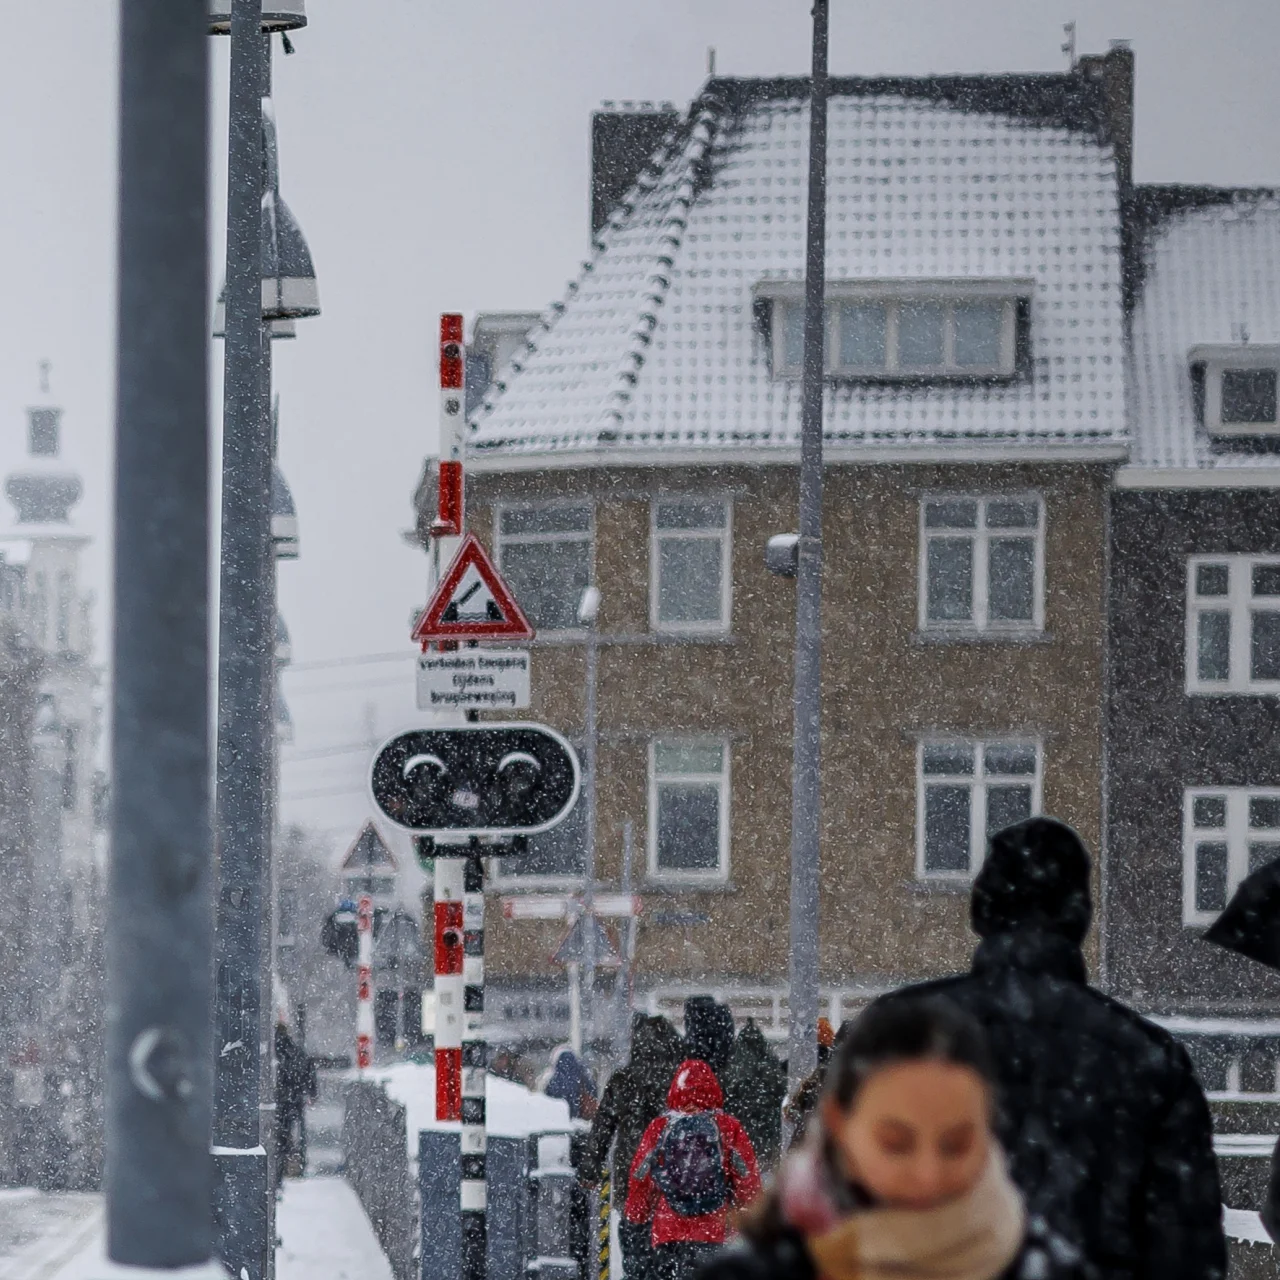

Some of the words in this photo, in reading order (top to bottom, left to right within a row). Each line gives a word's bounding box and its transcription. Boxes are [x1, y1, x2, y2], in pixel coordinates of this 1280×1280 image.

[478, 656, 526, 672] toegang
[452, 674, 494, 690] tijdens
[431, 690, 516, 706] brugbeweging
